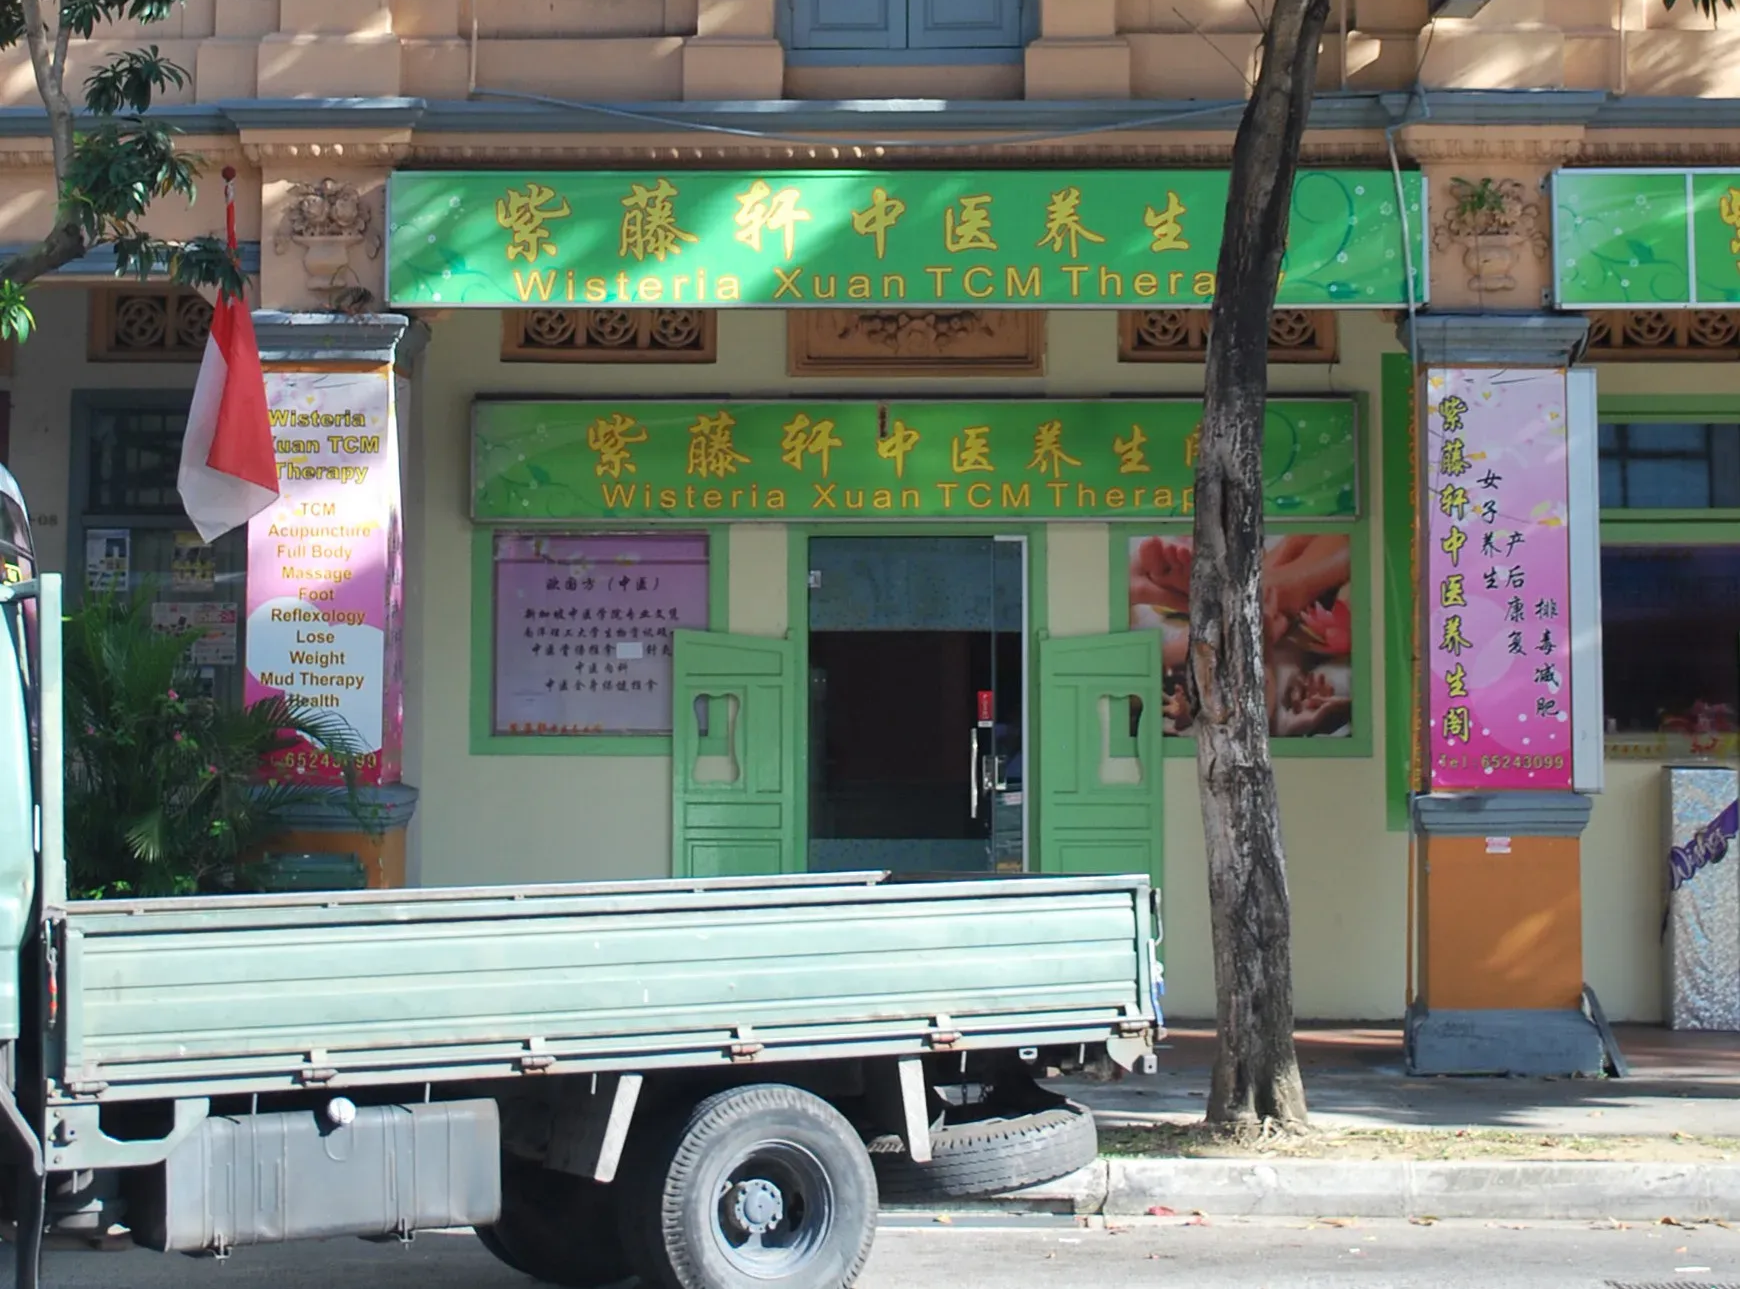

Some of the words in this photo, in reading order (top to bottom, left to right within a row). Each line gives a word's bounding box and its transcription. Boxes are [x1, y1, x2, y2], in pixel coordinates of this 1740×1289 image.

[495, 178, 1191, 262] 紫藤轩中医养生
[513, 269, 741, 302] Wisteria
[773, 267, 906, 300] Xuan
[925, 265, 1042, 299] TCM
[267, 409, 366, 427] Wisteria
[273, 435, 320, 454] uan
[327, 435, 380, 454] TCM
[587, 411, 1202, 479] 紫藤轩中医养生
[275, 462, 369, 484] Therapy
[602, 483, 786, 510] Wisteria
[812, 483, 920, 509] Xuan
[936, 483, 1030, 509] TCM
[1046, 482, 1196, 514] Therap
[300, 502, 336, 516] TCM
[268, 523, 372, 540] Acupuncture
[1476, 469, 1502, 589] 女子养生
[276, 544, 306, 558] Full
[312, 544, 352, 563] Body
[281, 566, 353, 583] Massage
[1438, 395, 1473, 744] 紫藤轩中医养生阁
[298, 588, 334, 601] Foot
[1504, 531, 1527, 656] 产后康复
[270, 608, 366, 626] Reflexology
[296, 630, 335, 643] Lose
[289, 651, 345, 668] Weight
[1534, 597, 1560, 717] 排毒减肥
[260, 672, 294, 686] Mud
[300, 672, 365, 690] Therapy
[289, 693, 340, 708] Health
